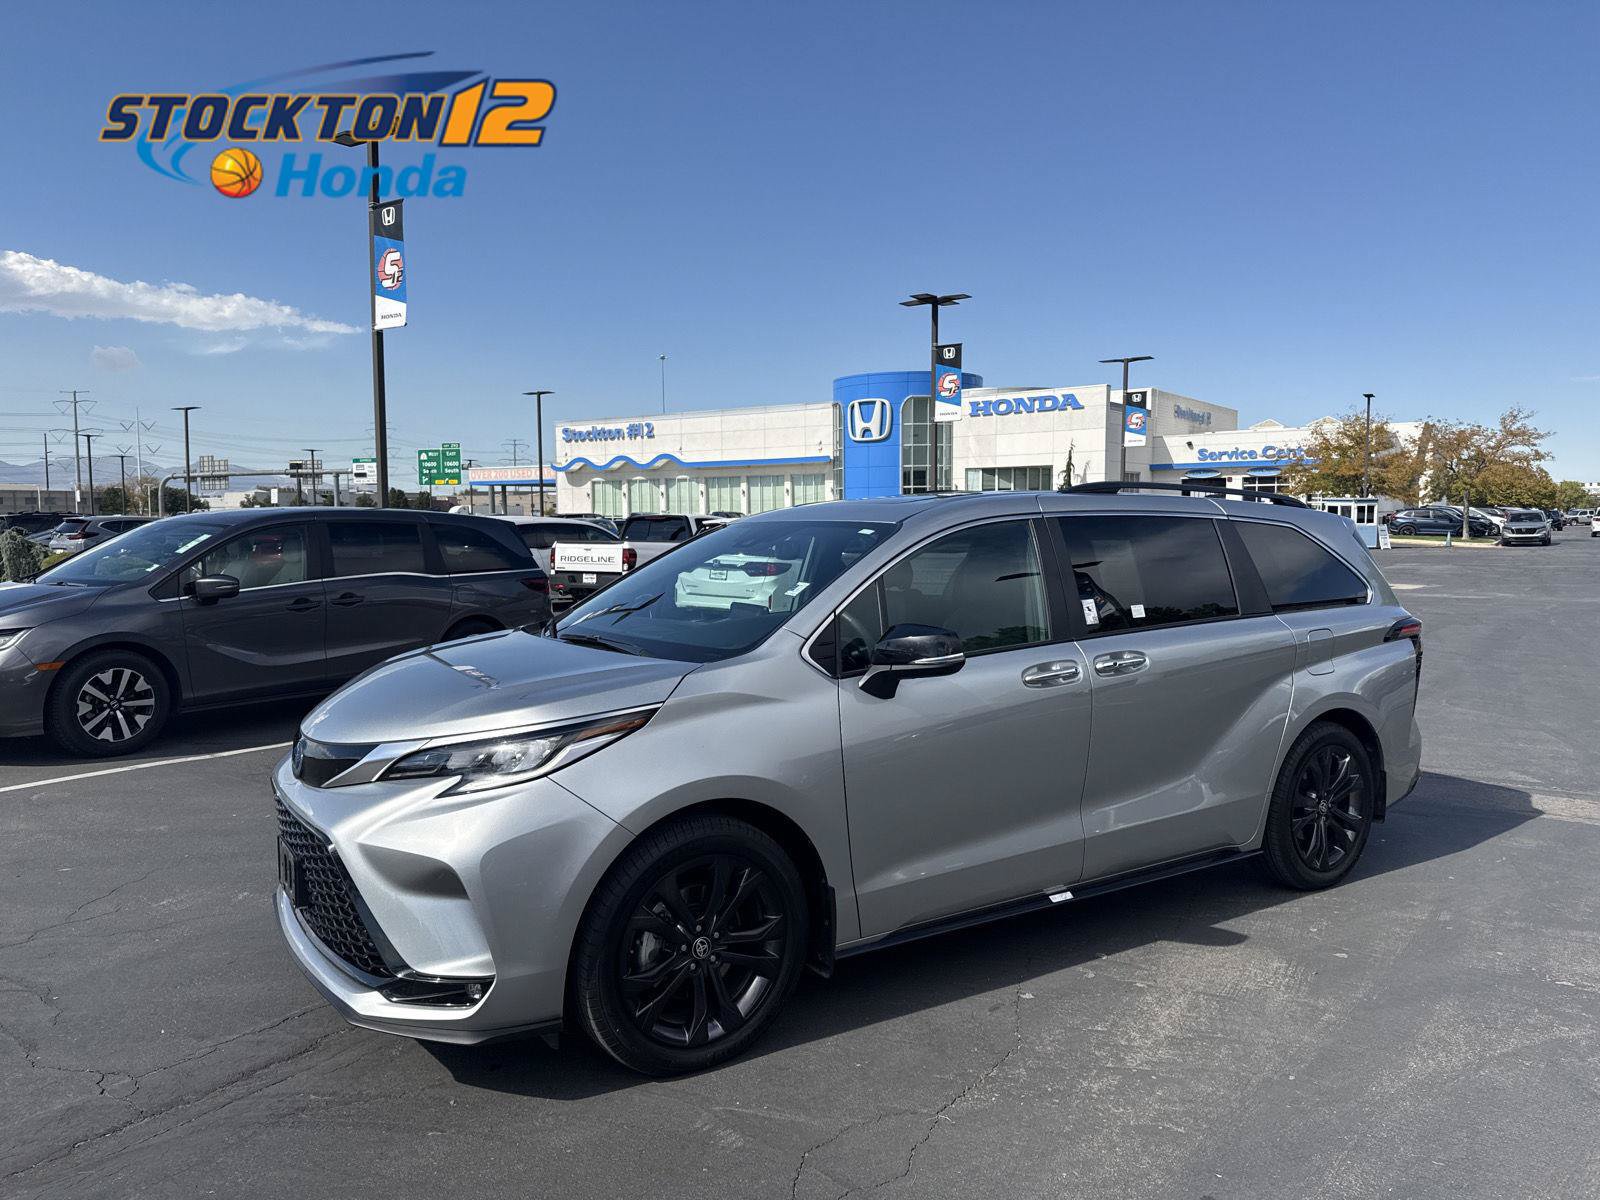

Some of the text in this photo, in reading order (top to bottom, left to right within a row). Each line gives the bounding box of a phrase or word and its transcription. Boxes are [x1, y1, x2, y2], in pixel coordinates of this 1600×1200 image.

[380, 312, 402, 320] HONDA
[969, 393, 1085, 418] HONDA
[562, 422, 655, 443] Stockton #12
[1197, 445, 1307, 461] Service Cent
[471, 470, 492, 479] OVER
[511, 468, 533, 478] USED
[560, 555, 616, 563] RIDGELINE
